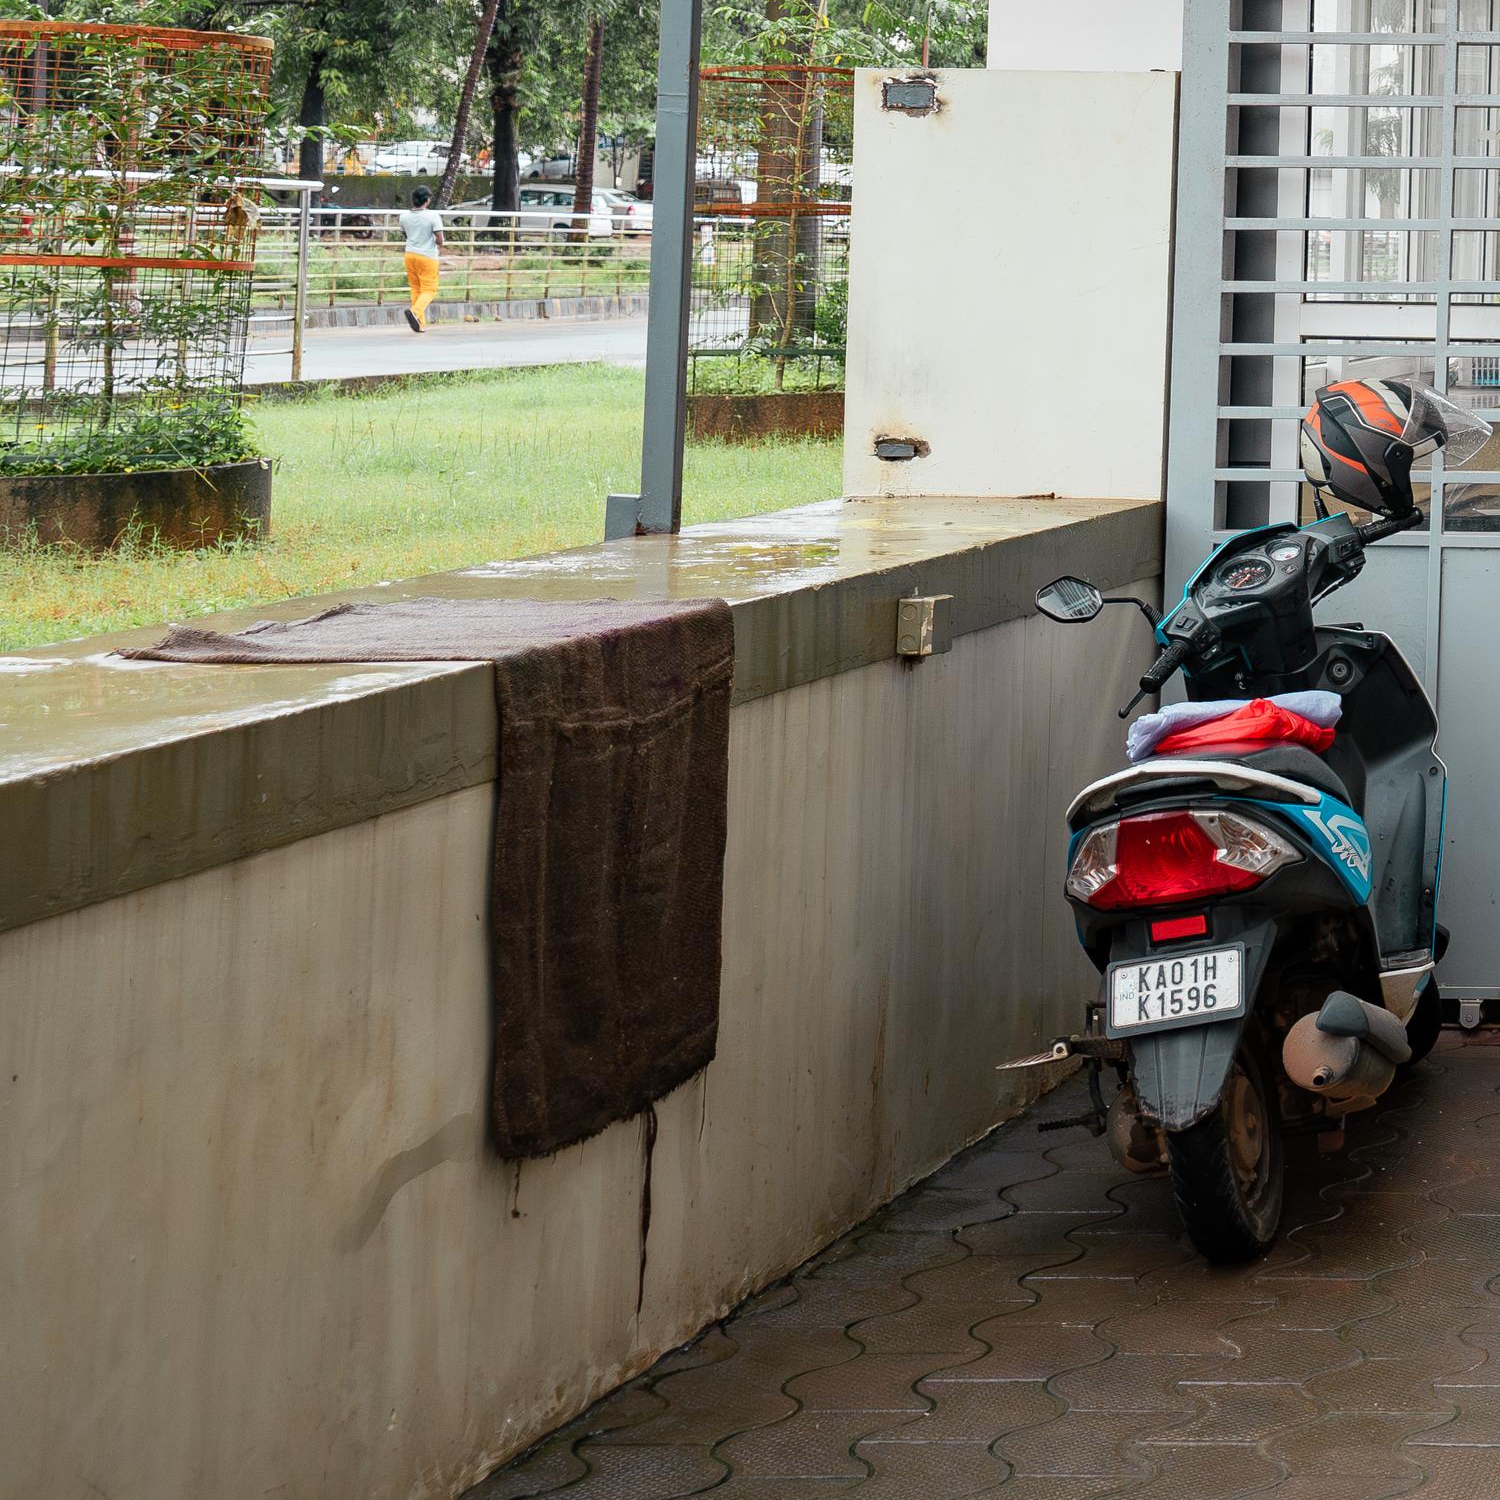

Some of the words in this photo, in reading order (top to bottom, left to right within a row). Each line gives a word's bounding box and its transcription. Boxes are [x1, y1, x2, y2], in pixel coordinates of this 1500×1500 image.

[1138, 955, 1217, 993] KA01H
[1120, 991, 1135, 1001] IND
[1138, 984, 1217, 1021] K1596
